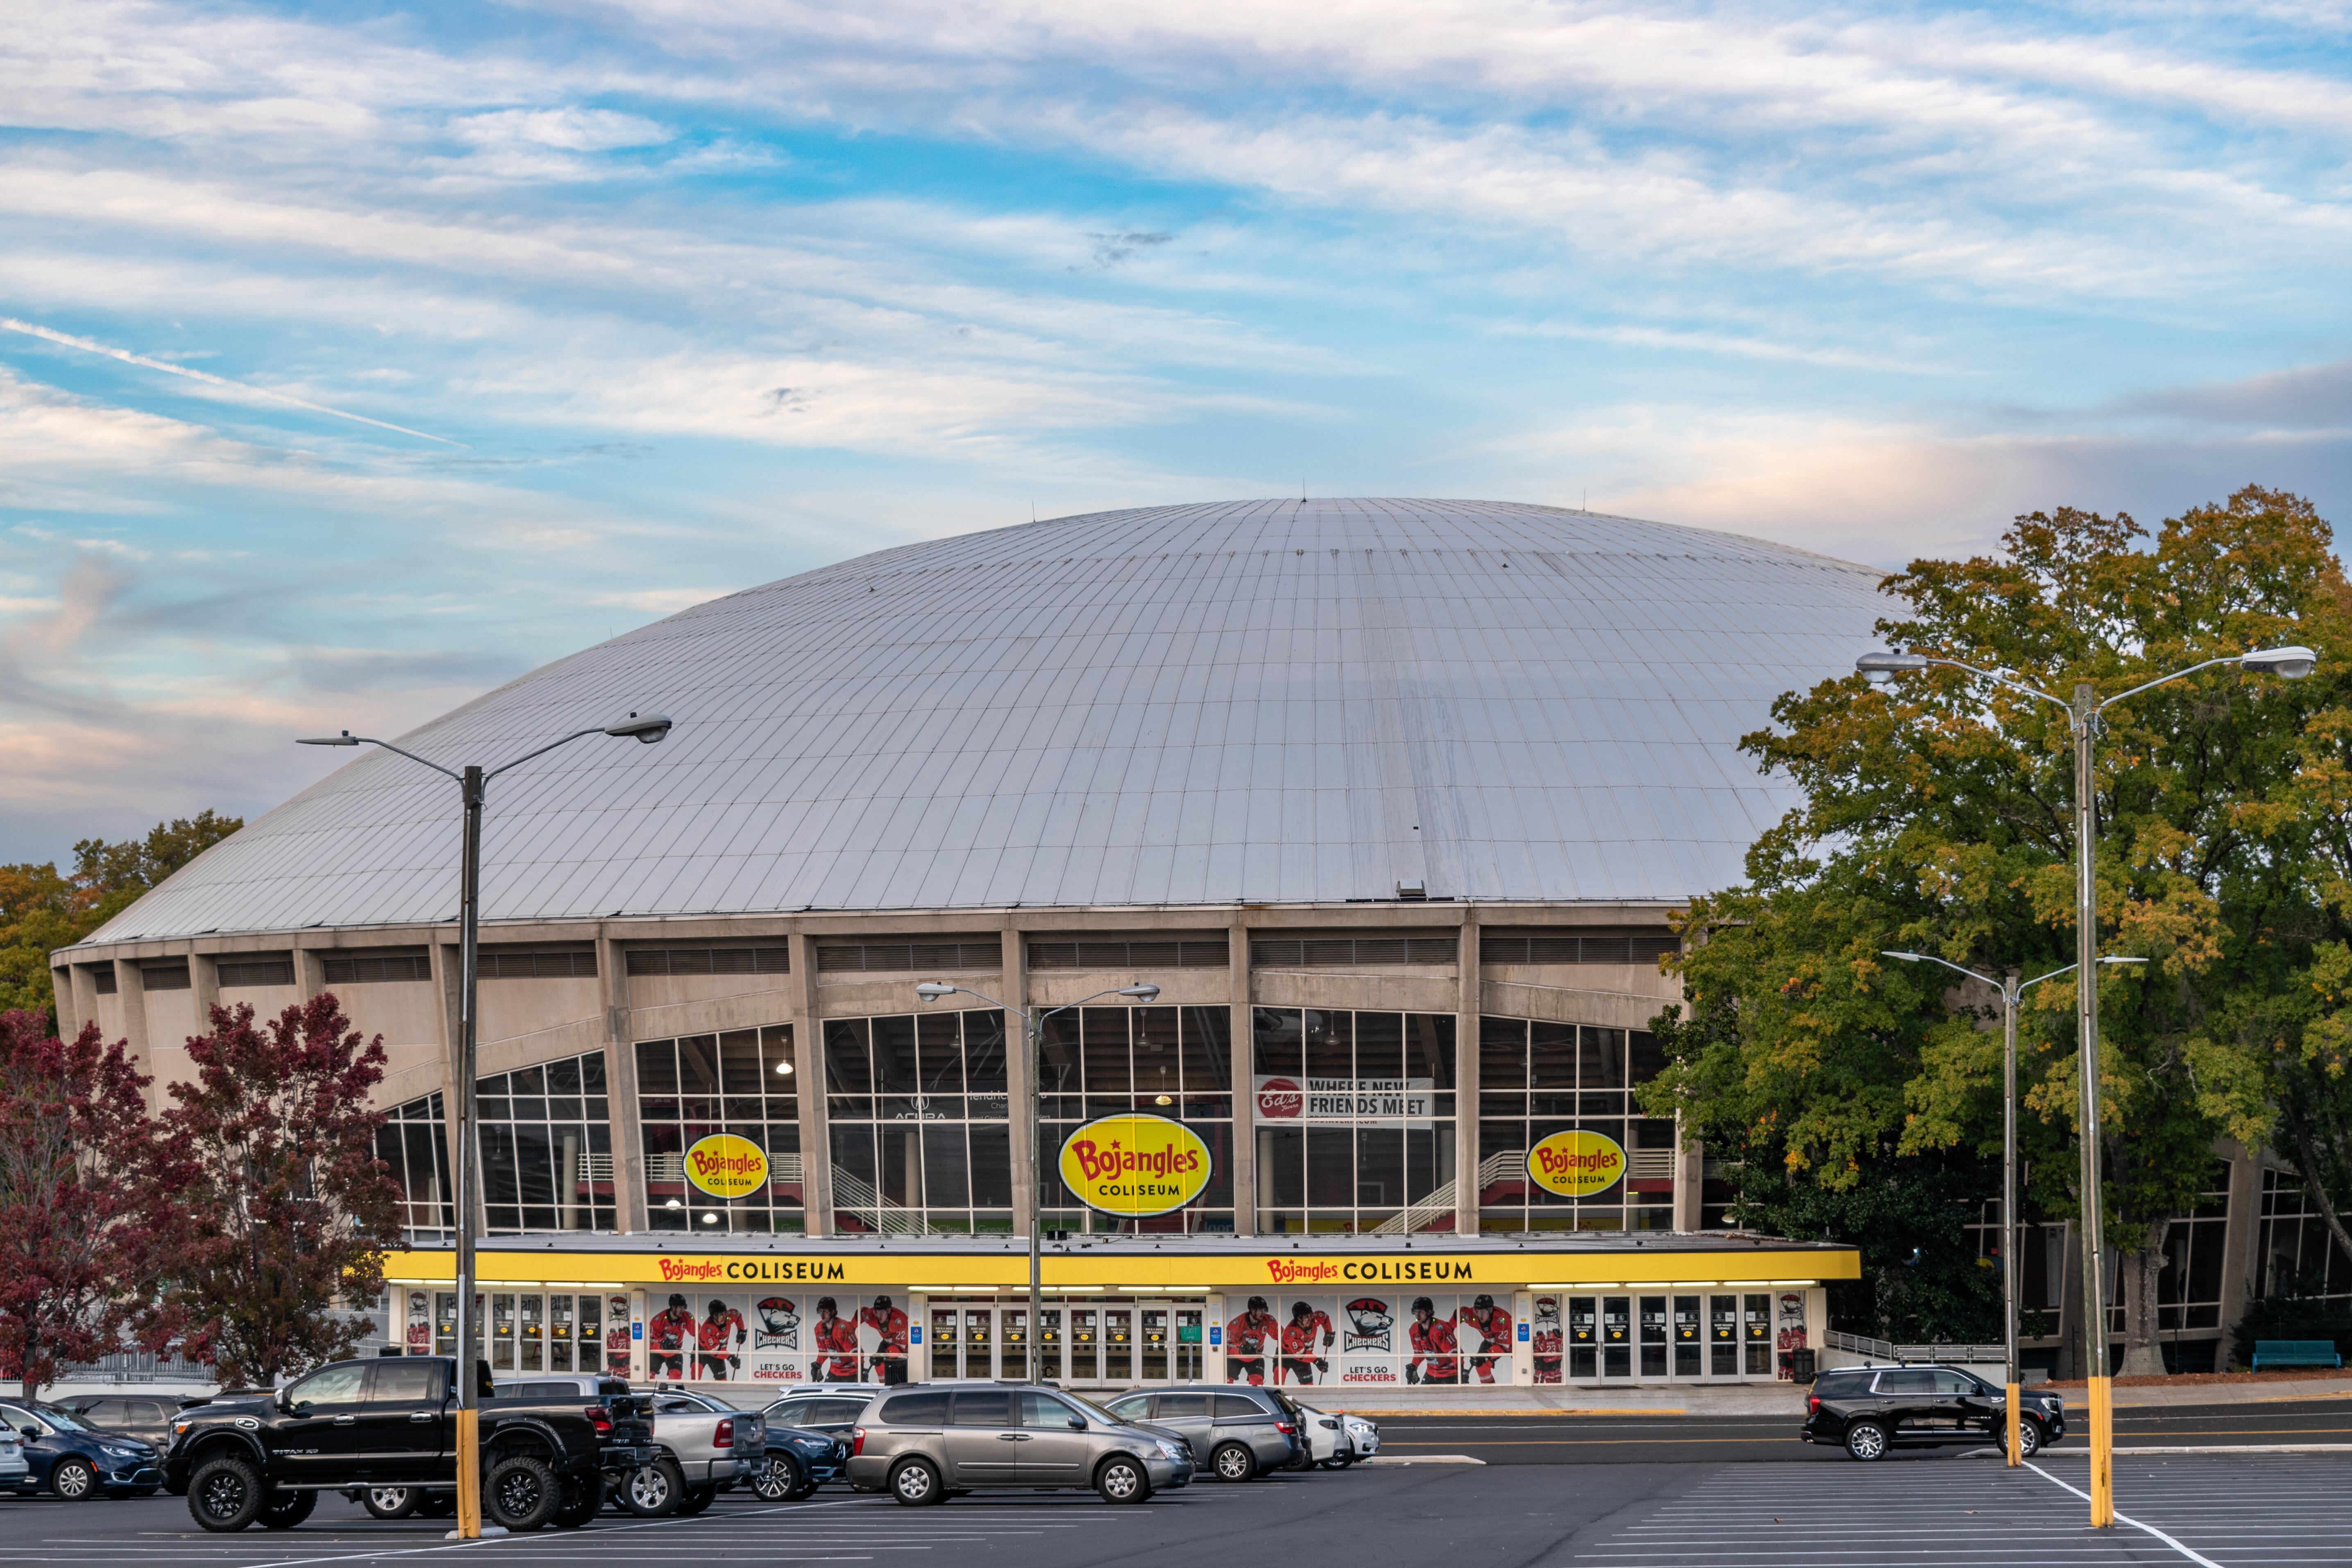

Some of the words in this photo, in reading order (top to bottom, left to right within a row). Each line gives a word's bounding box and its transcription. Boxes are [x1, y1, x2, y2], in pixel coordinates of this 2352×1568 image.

[1372, 1082, 1410, 1096] NEW
[1261, 1089, 1299, 1107] Ed's
[1311, 1098, 1377, 1114] FRIENDS
[1383, 1099, 1424, 1114] MEET
[691, 1150, 762, 1176] Bojangles
[1071, 1139, 1199, 1181] Bojangles
[1536, 1147, 1617, 1174] Bojangles
[1099, 1185, 1180, 1196] COLISEUM
[659, 1258, 722, 1281] Bojangles
[727, 1262, 844, 1279] COLISEUM
[1267, 1259, 1338, 1283] Bojangles
[1343, 1262, 1472, 1279] COLISEUM
[895, 1331, 905, 1340] 22
[1262, 1326, 1267, 1334] C
[1498, 1330, 1508, 1339] 22
[757, 1331, 796, 1348] CHECKERS
[848, 1334, 857, 1344] 11
[1346, 1332, 1388, 1350] CHECKERS
[1446, 1334, 1455, 1344] 11
[754, 1371, 802, 1379] CHECKERS
[1343, 1373, 1396, 1382] CHECKERS
